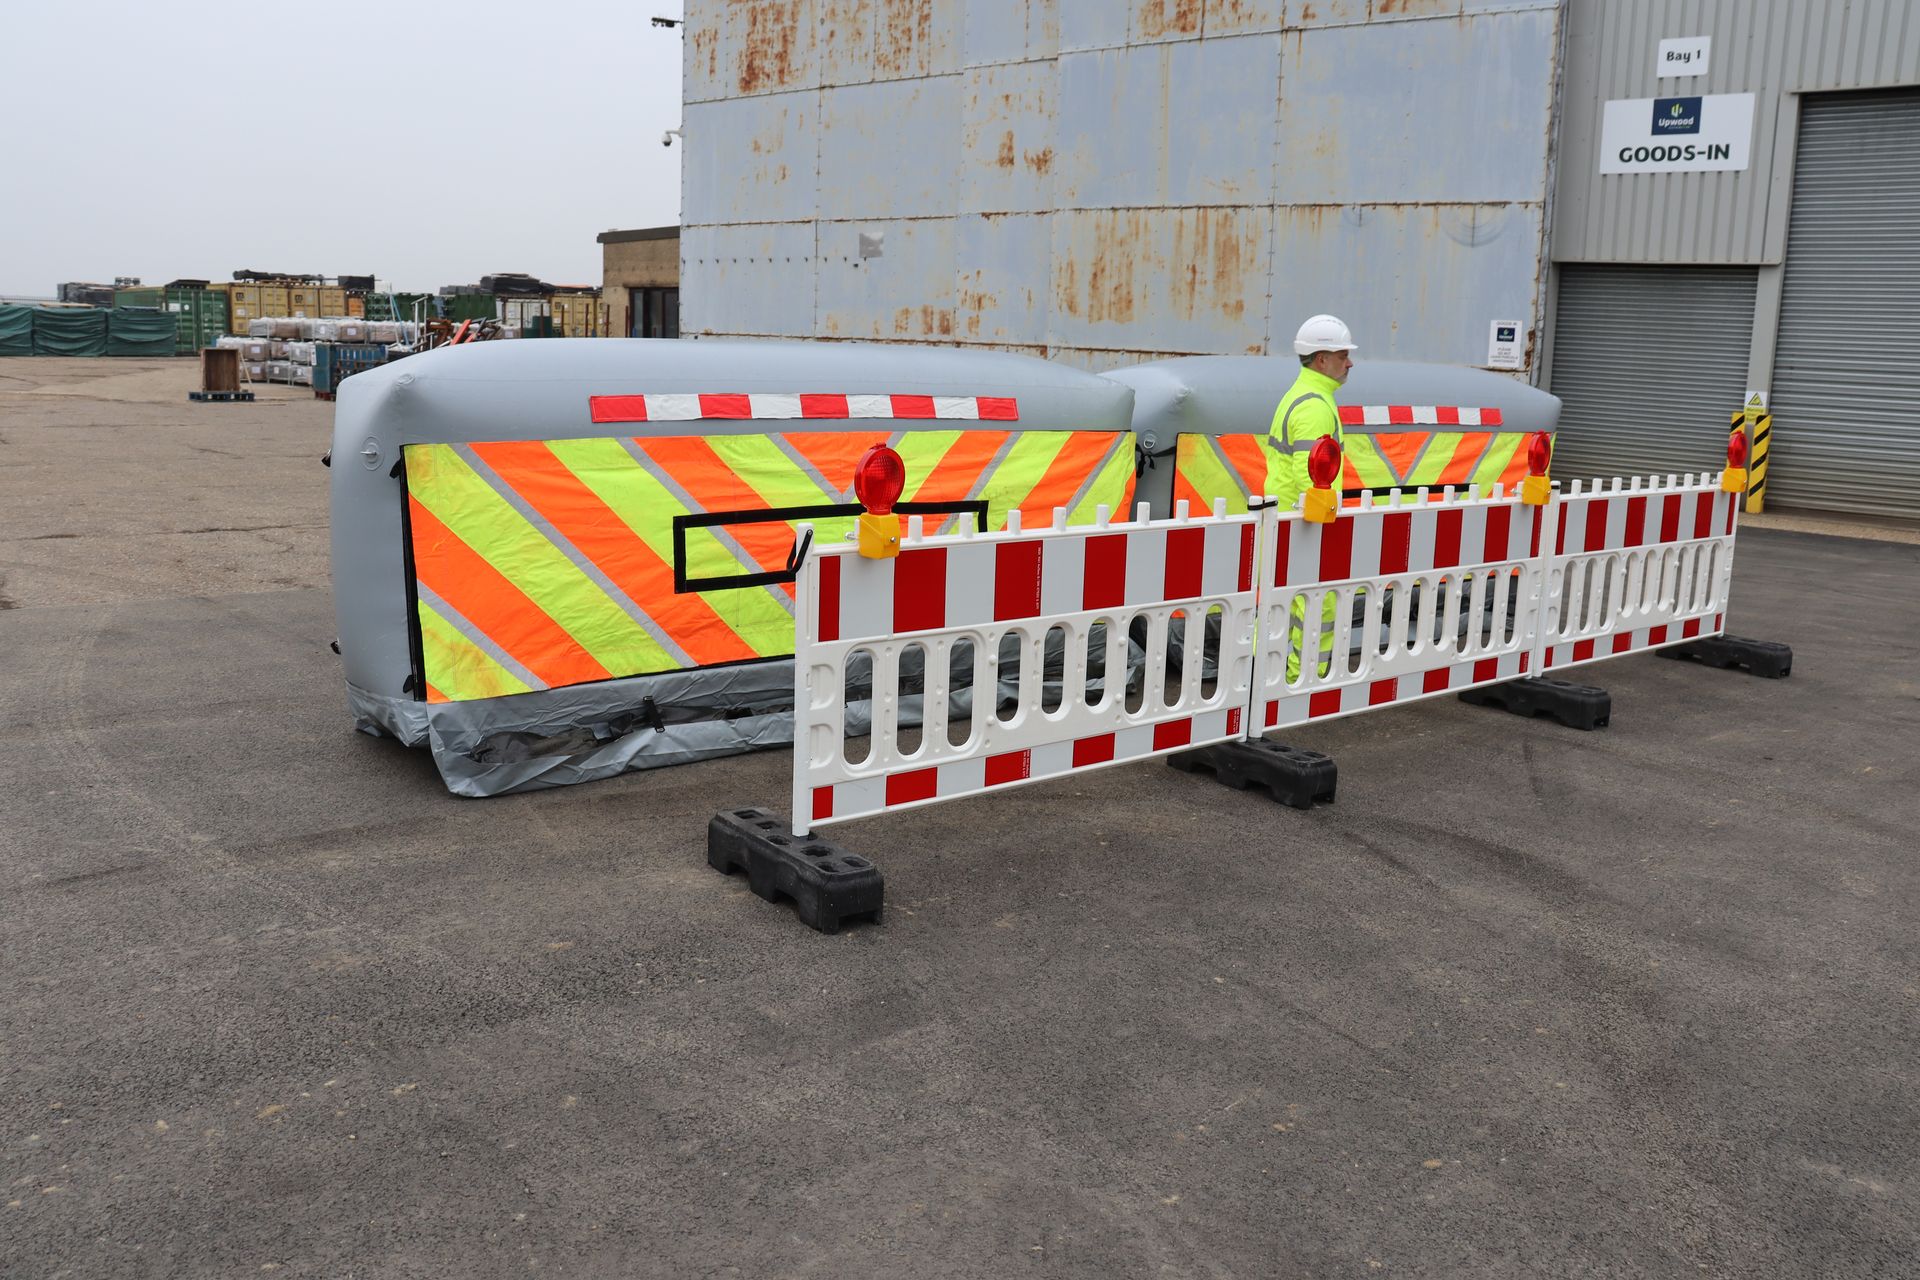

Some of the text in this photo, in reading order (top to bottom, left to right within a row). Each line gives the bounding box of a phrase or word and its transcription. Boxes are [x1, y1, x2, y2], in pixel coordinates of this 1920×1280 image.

[1666, 49, 1701, 63] Bay 1
[1658, 116, 1695, 127] Upwood
[1619, 144, 1730, 163] GOODS-IN
